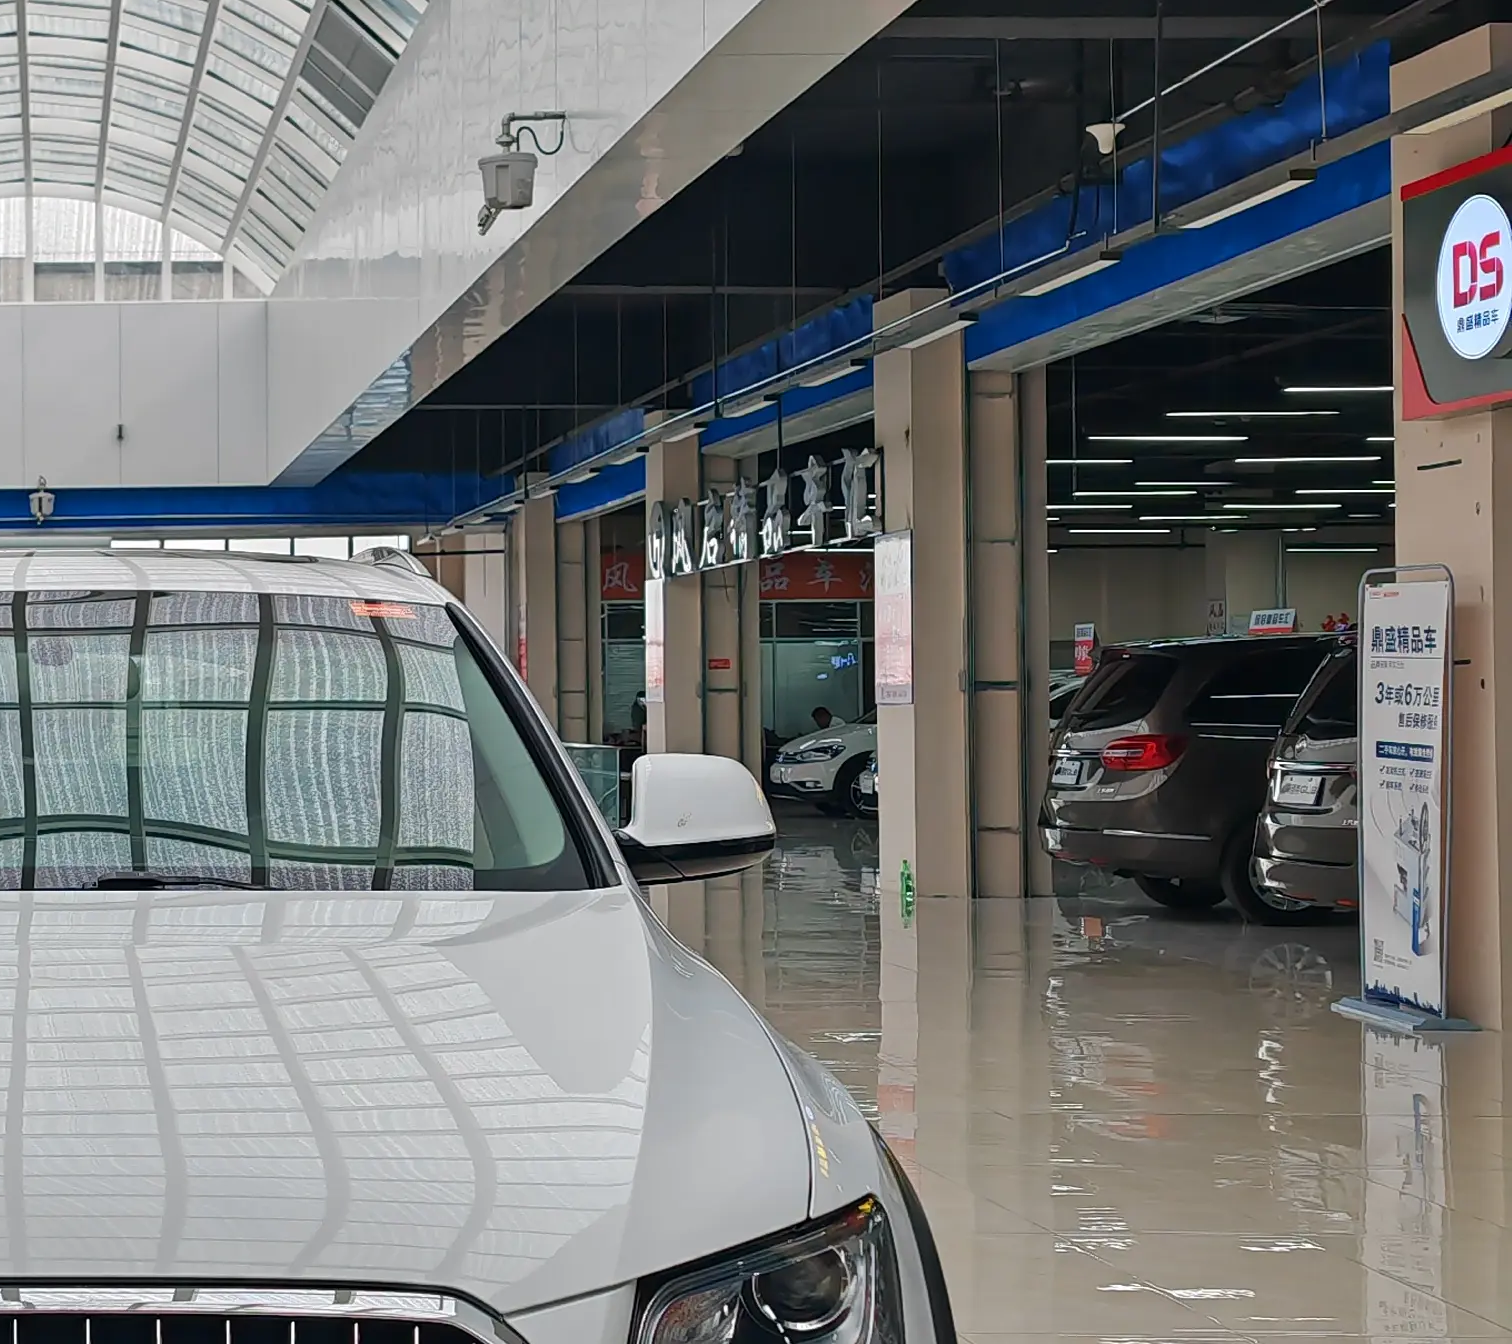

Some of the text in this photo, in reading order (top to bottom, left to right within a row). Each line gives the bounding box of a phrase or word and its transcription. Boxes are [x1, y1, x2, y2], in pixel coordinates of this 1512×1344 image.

[1452, 230, 1504, 309] DS
[1371, 625, 1437, 654] 鼎盛精品车
[1375, 681, 1440, 707] 3年或6万公里
